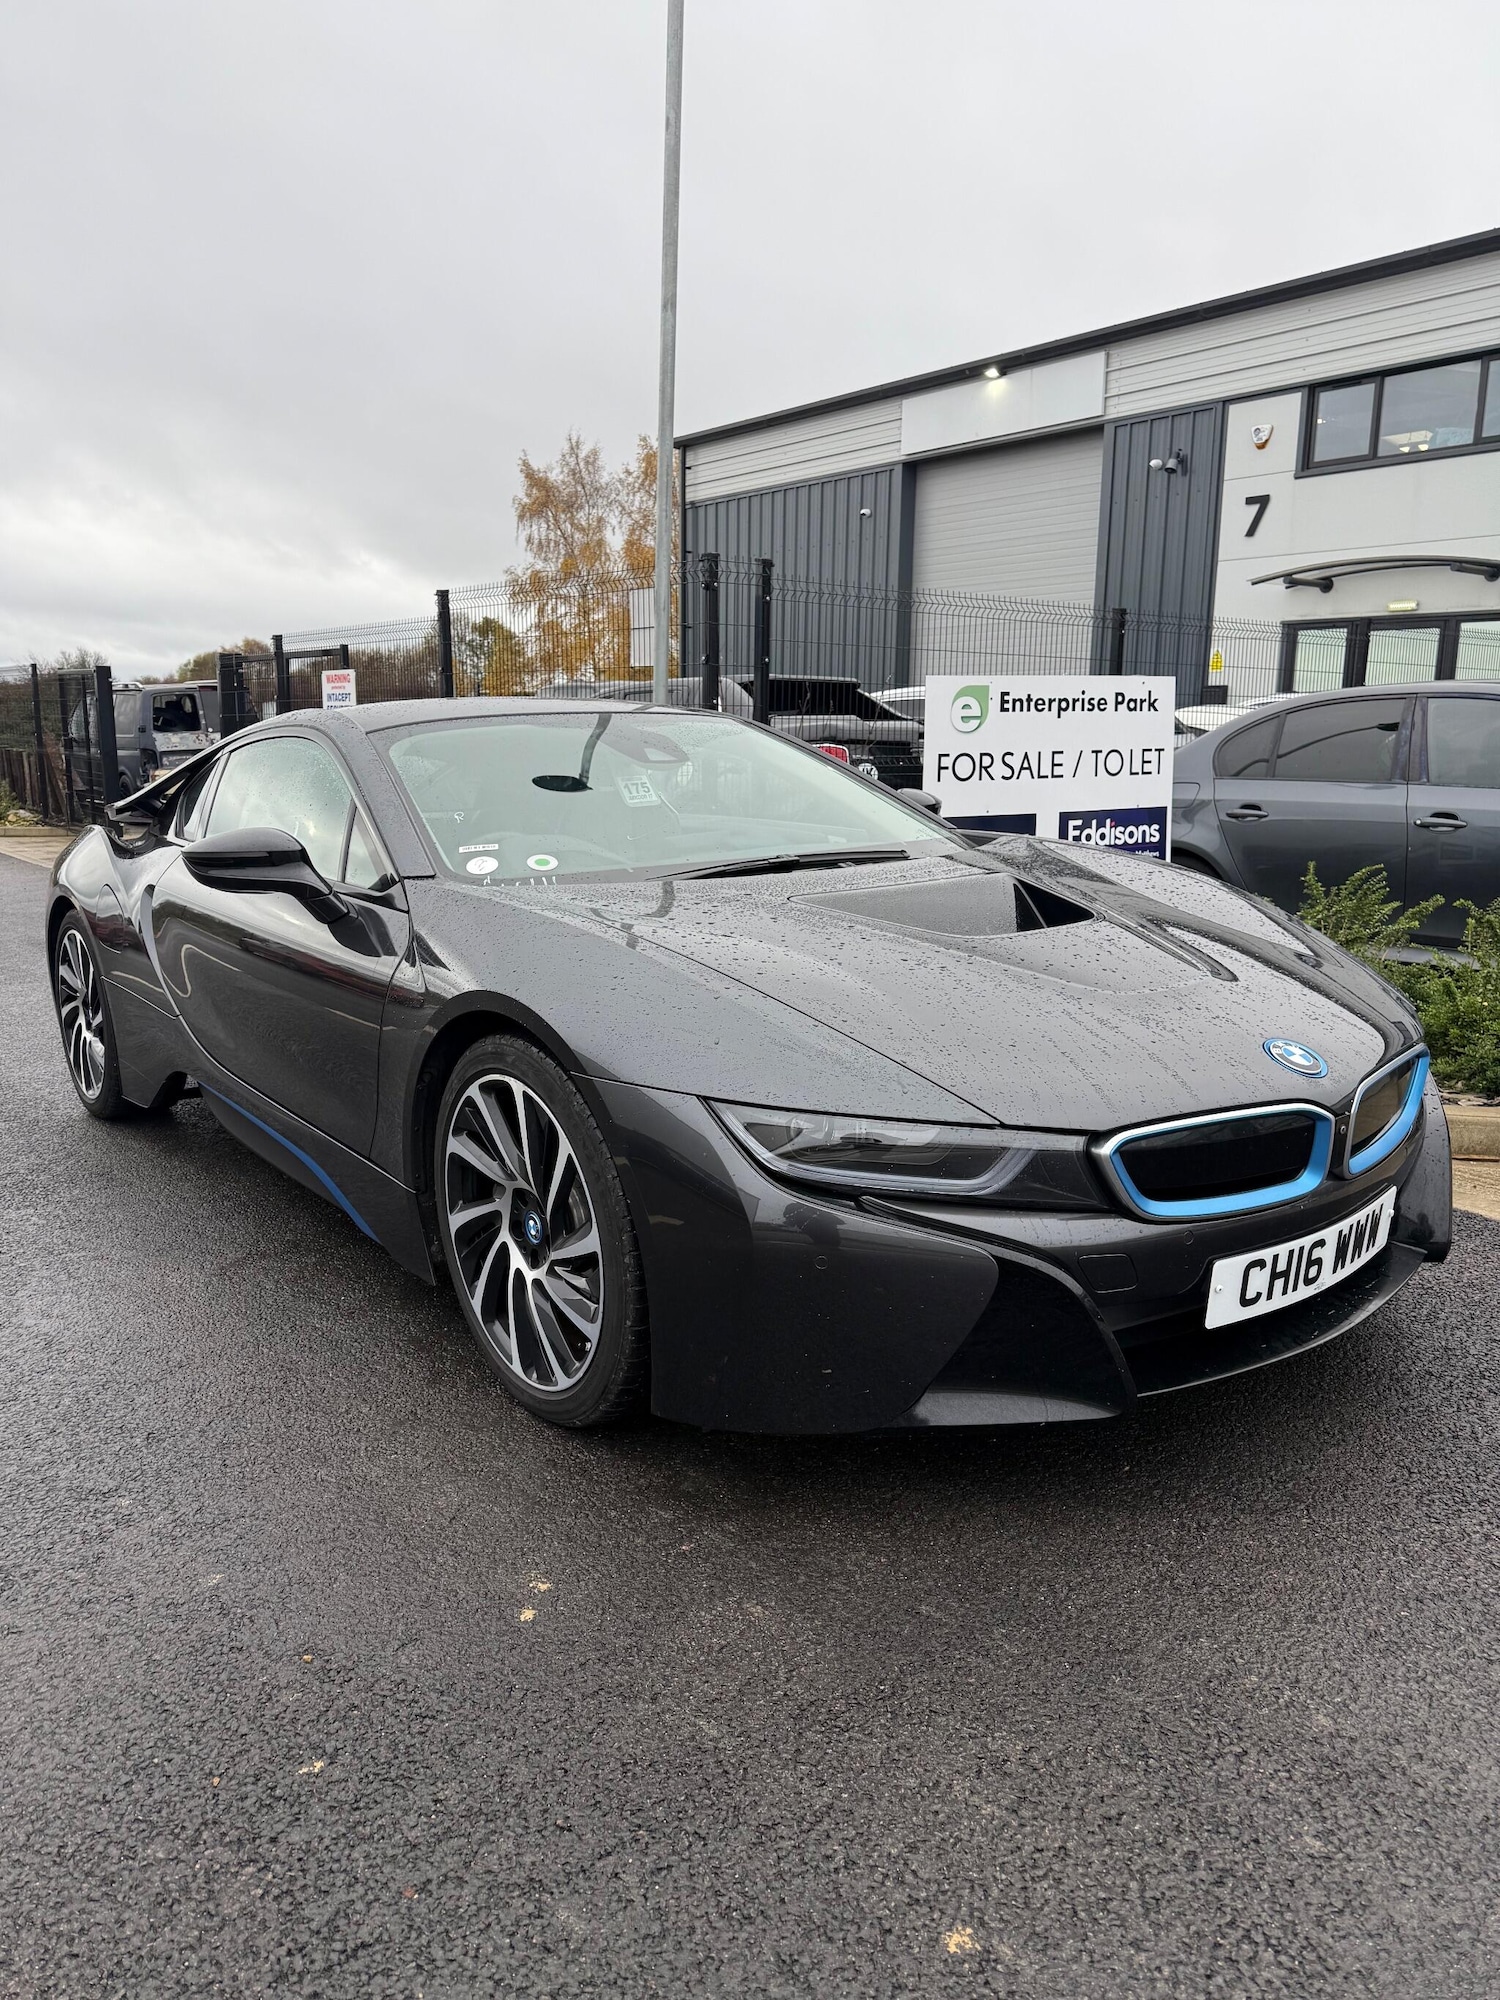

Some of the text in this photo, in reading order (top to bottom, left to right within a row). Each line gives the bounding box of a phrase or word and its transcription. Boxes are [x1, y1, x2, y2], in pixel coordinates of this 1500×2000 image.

[1244, 494, 1271, 538] 7
[326, 673, 351, 684] WARNING
[327, 692, 351, 702] INTACEPT
[999, 690, 1159, 719] Enterprise Park
[937, 752, 996, 783] FOR
[1001, 750, 1065, 781] SALE
[1091, 749, 1124, 778] TO
[1129, 748, 1165, 776] LET
[623, 782, 651, 795] 175
[1068, 818, 1160, 846] Eddisons
[1239, 1203, 1384, 1308] CH16 WWW
